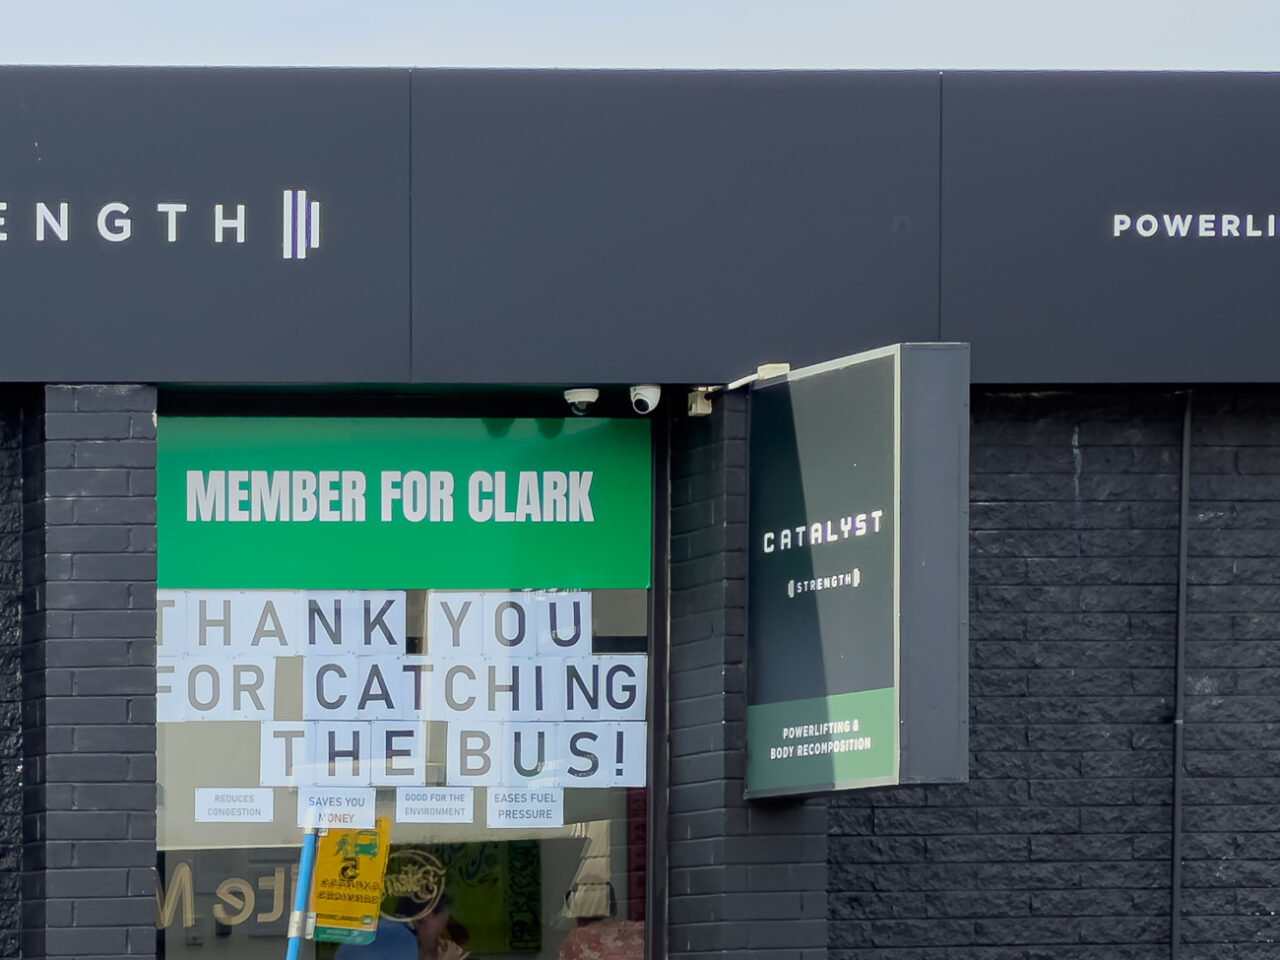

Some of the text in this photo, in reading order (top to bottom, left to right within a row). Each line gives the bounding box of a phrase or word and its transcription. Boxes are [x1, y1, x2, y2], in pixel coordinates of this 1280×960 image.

[1112, 213, 1276, 238] POWERLI
[186, 470, 595, 522] MEMBER FOR CLARK
[763, 509, 884, 553] CATALYST
[795, 573, 852, 594] STRENGTH
[157, 598, 581, 648] THANK YOU
[315, 663, 638, 712] CATCHING
[782, 719, 860, 740] POWERLIFTING &
[272, 729, 626, 778] THE BUS!
[770, 737, 872, 760] BODY RECOMPOSITION
[214, 794, 255, 804] REDUCES
[308, 796, 365, 808] SAVES YOU
[404, 793, 465, 802] GOOD FOR THE
[494, 793, 557, 803] EASES FUEL
[207, 807, 262, 817] CONGESTION
[404, 807, 466, 816] ENVIRONMENT
[498, 809, 553, 819] PRESSURE
